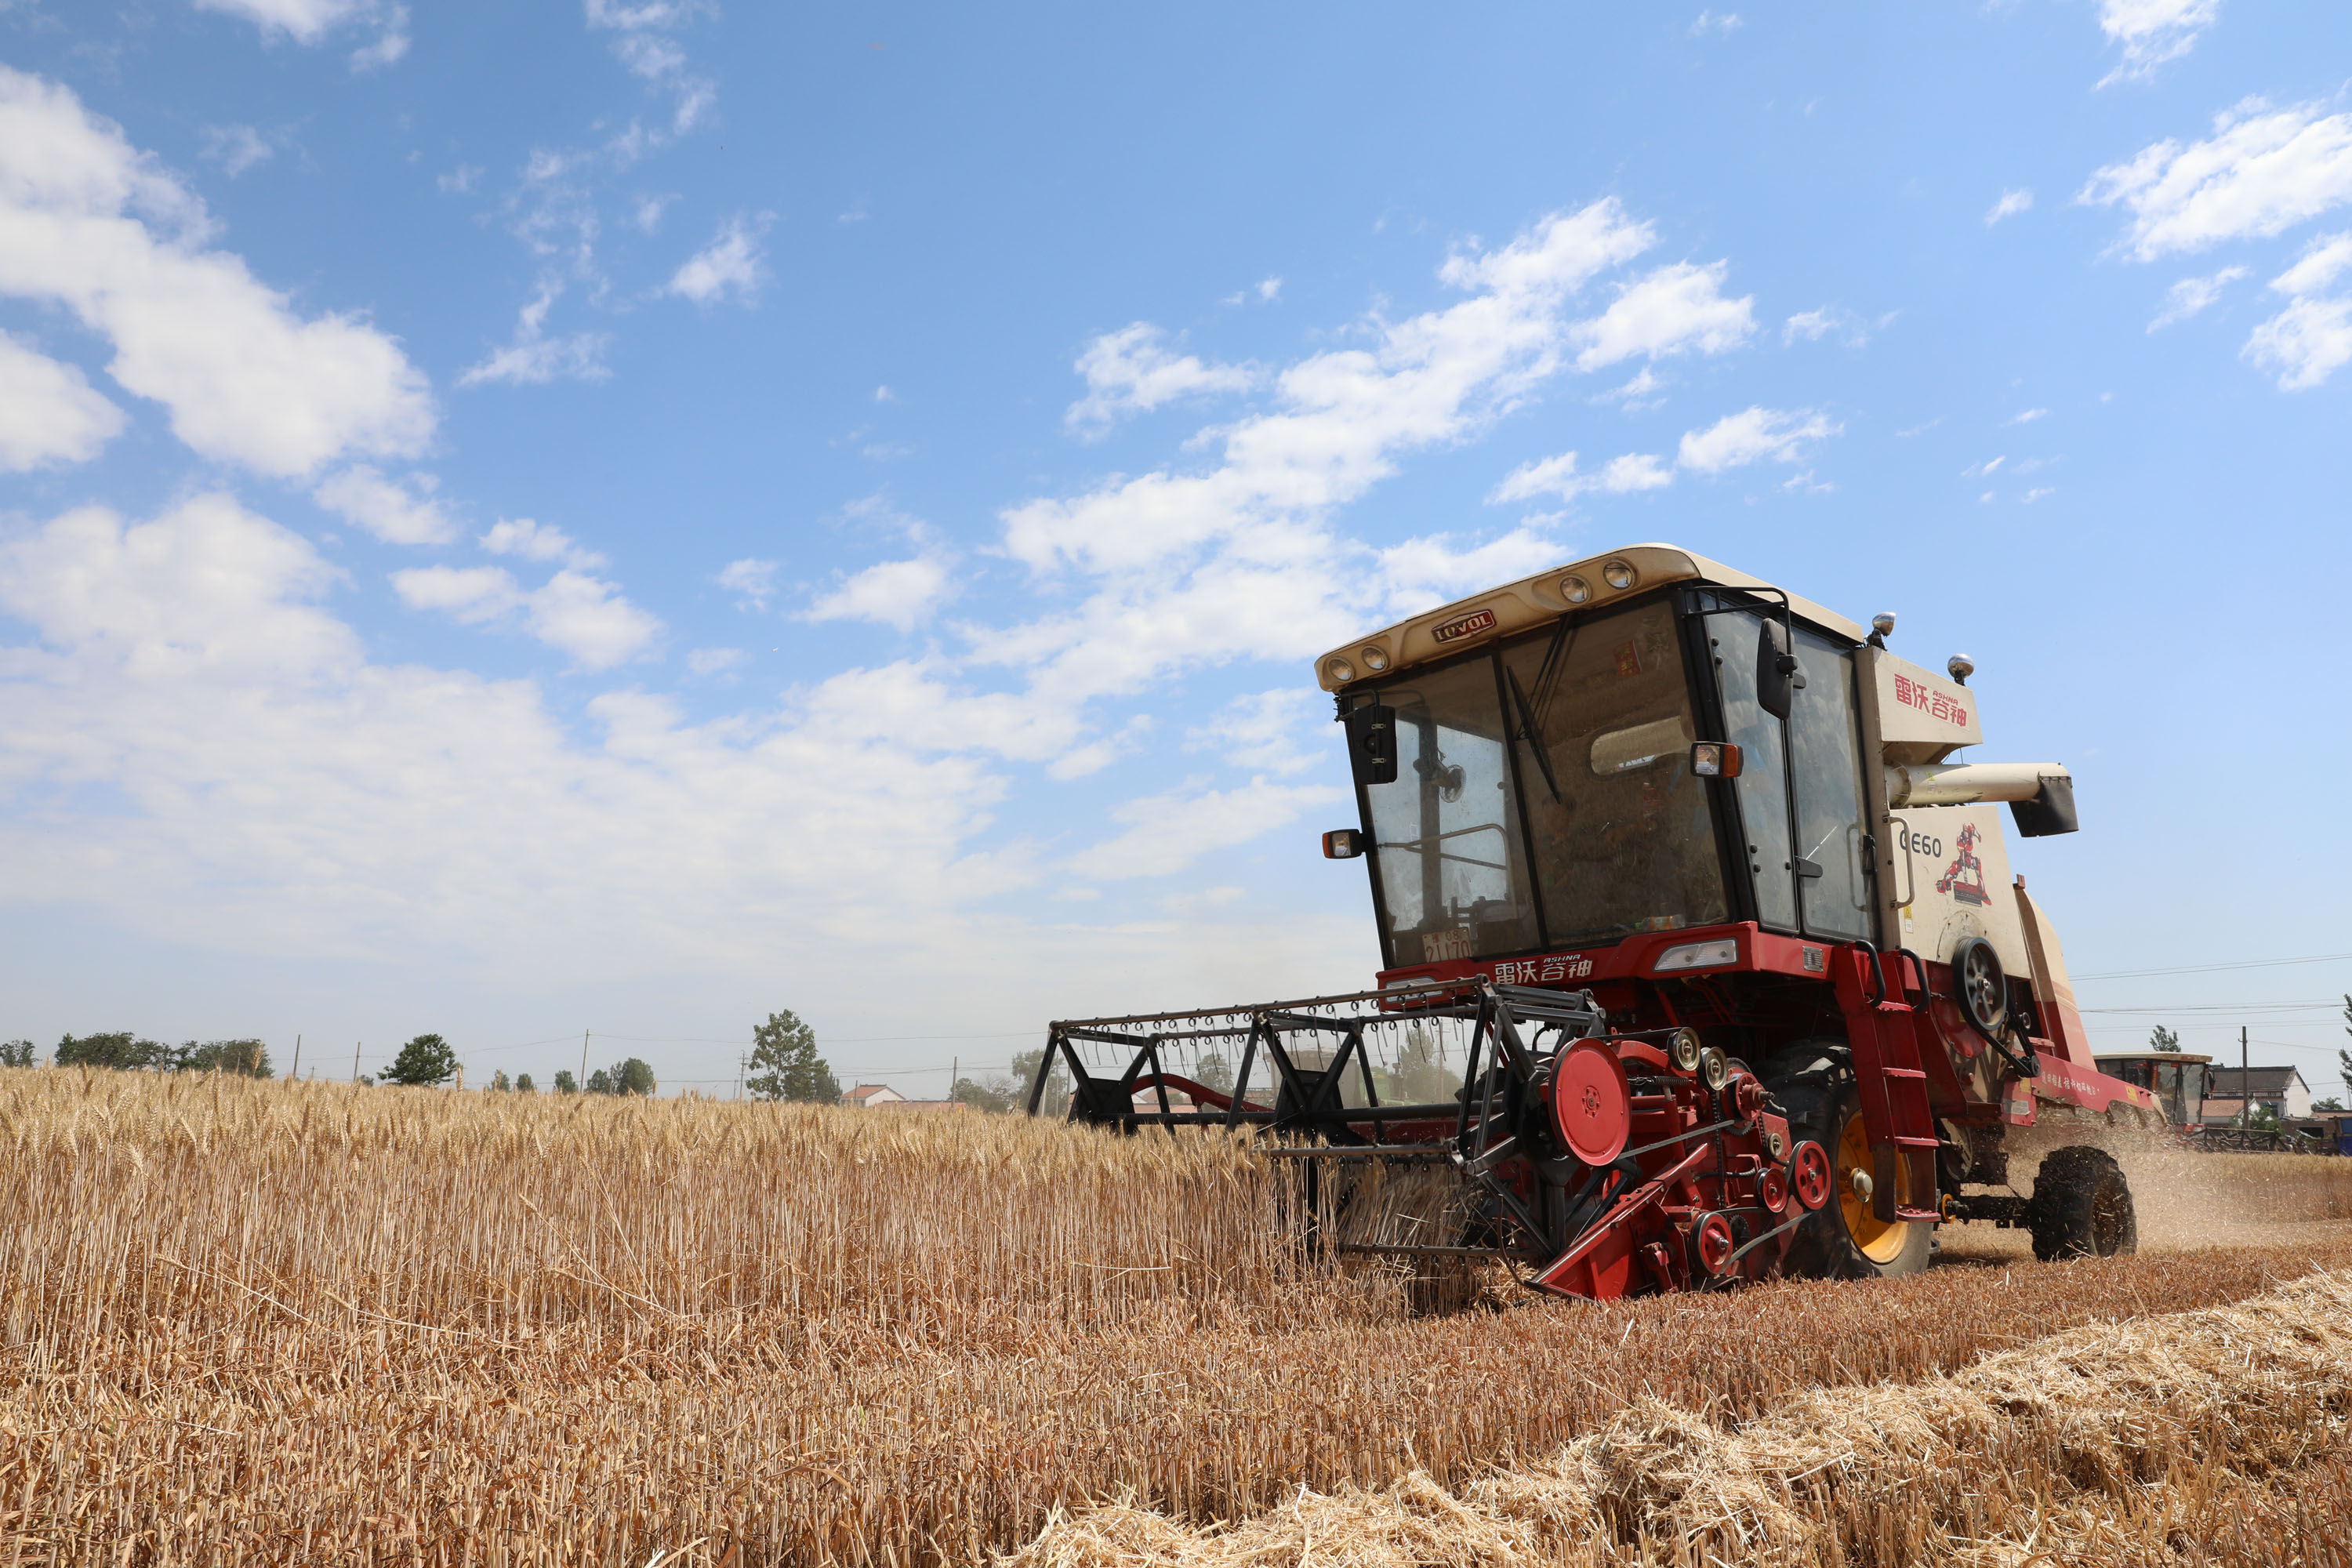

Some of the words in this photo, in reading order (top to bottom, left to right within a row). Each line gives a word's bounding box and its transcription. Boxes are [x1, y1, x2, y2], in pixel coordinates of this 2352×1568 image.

[1894, 673, 1967, 727] 雷沃谷神
[1933, 691, 1958, 706] ASHNA
[1543, 954, 1581, 964] ASHNA
[1495, 960, 1593, 984] 雷沃谷神
